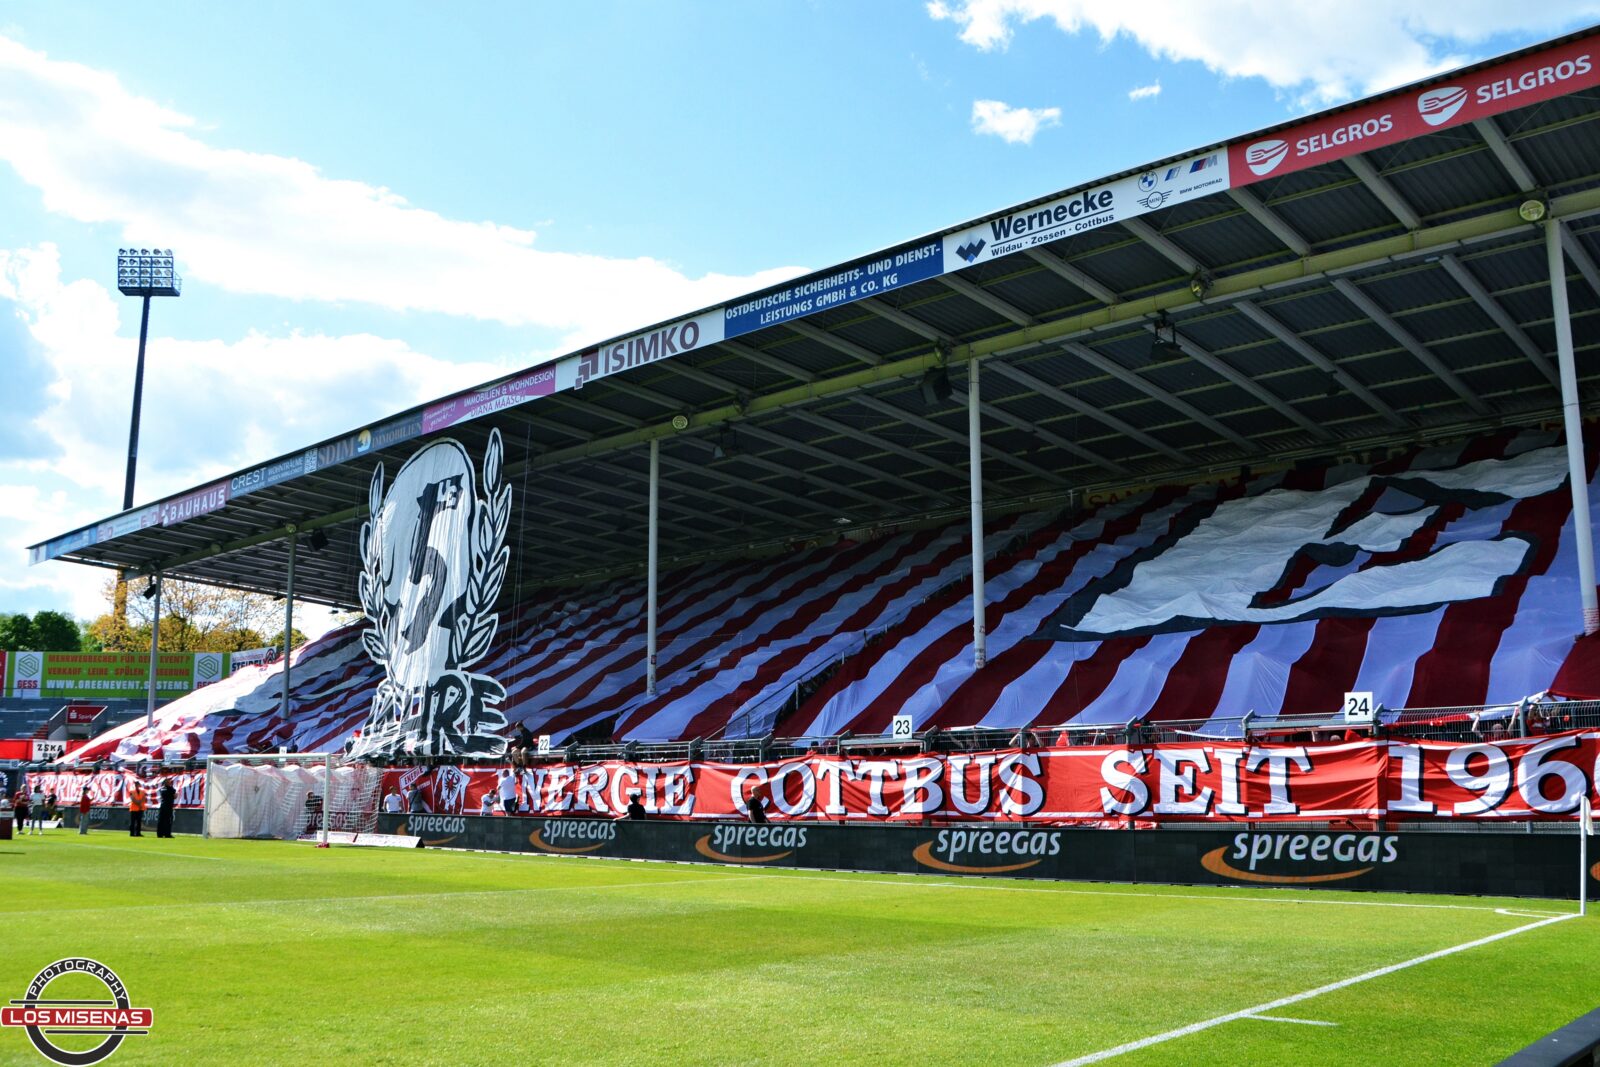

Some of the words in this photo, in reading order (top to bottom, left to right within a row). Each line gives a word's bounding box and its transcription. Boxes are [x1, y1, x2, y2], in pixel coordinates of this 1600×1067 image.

[1476, 55, 1592, 104] SELGROS
[1296, 114, 1393, 157] SELGROS
[1193, 178, 1223, 191] MOTORRAD
[990, 189, 1113, 241] Wernecke
[991, 242, 1023, 257] Wildau
[1031, 229, 1066, 244] Zossen
[1074, 214, 1114, 232] Cottbus
[725, 290, 792, 320] OSTDEUTSCHE
[794, 266, 864, 298] SICHERHEITS-
[867, 258, 892, 275] UND
[895, 243, 941, 266] DIENST-
[760, 299, 813, 325] LEISTUNGS
[816, 289, 846, 308] GMBH
[850, 286, 857, 296] &
[860, 279, 879, 293] CO.
[882, 273, 898, 288] KG
[508, 369, 555, 392] WOHNDESIGN
[231, 467, 266, 491] CREST
[170, 488, 226, 521] BAUHAUS
[46, 680, 189, 689] WWW.GREENEVENT.SSTEMS
[1348, 697, 1370, 717] 24
[894, 719, 911, 736] 23
[37, 743, 63, 752] ZSKA
[539, 739, 549, 751] 22
[497, 762, 695, 816] NERGIE
[731, 750, 1046, 818] COTTBUS
[1099, 744, 1312, 817] SEIT
[1387, 734, 1600, 815] 196
